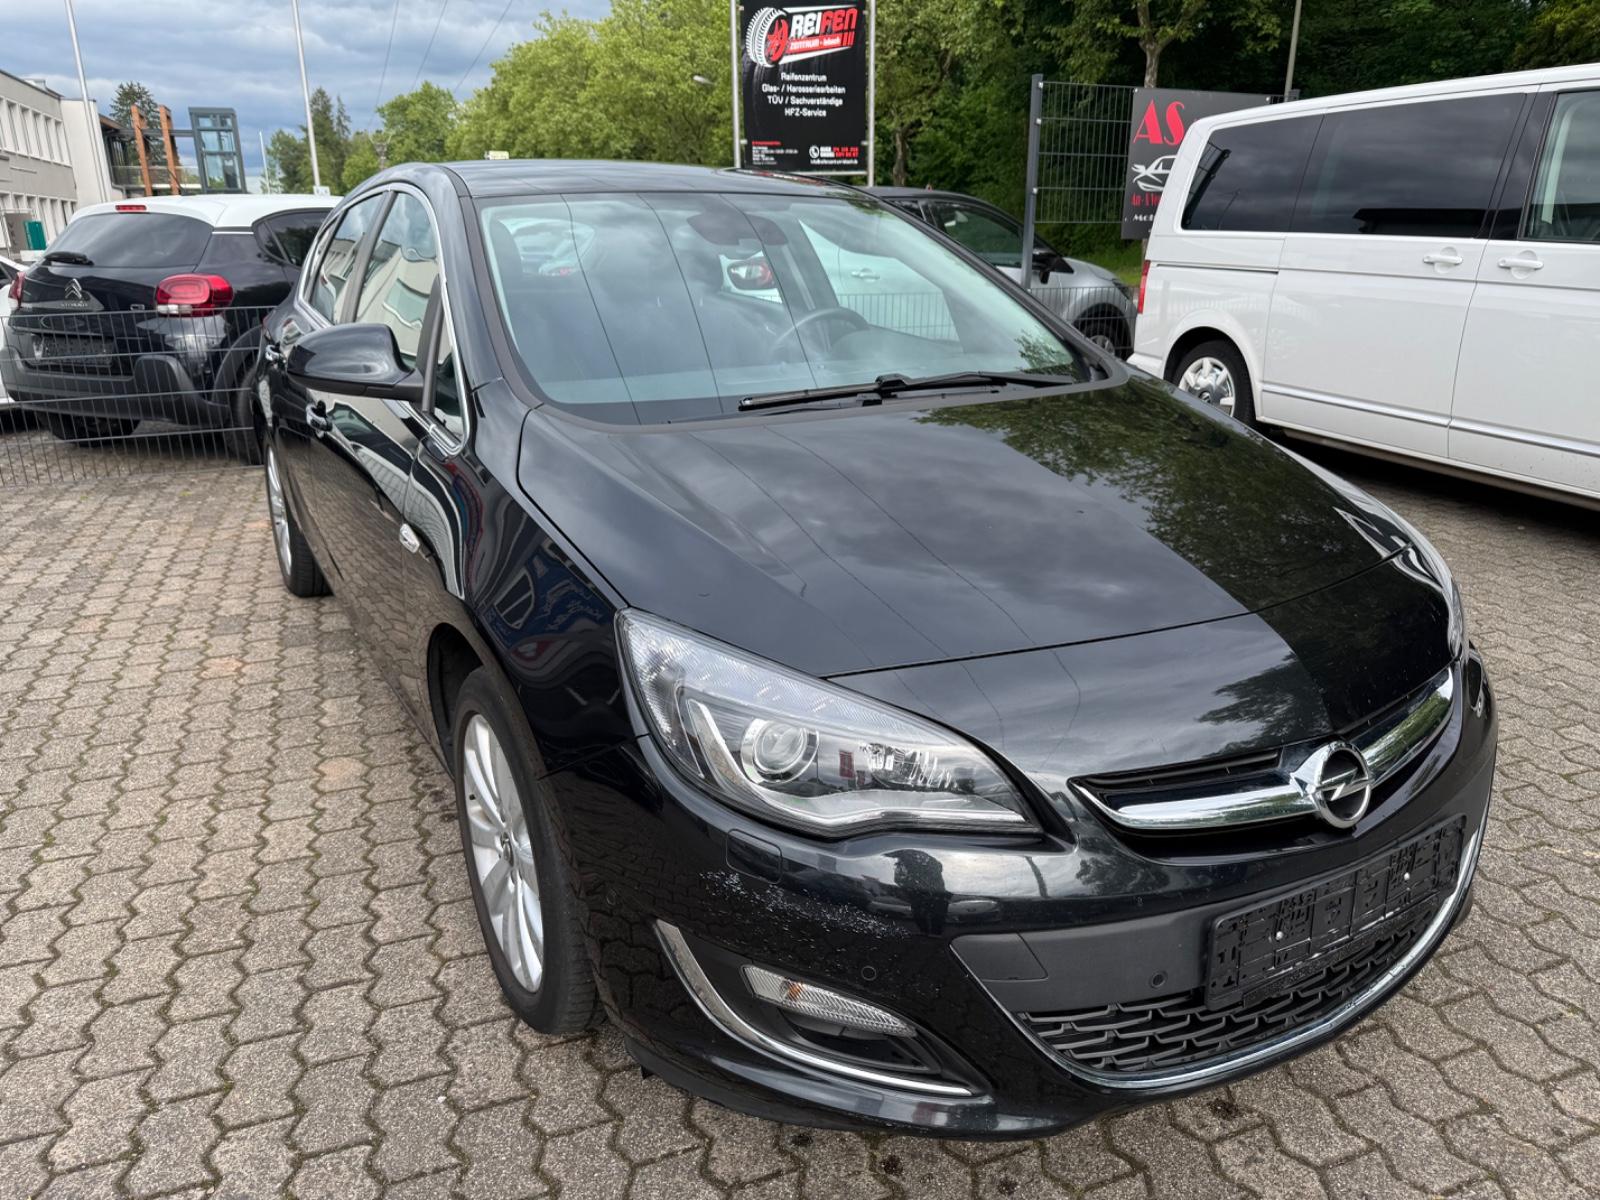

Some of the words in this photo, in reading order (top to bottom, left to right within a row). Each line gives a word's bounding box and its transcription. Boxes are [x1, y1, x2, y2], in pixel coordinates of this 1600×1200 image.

[790, 8, 858, 39] REIFEN
[780, 72, 827, 81] Reifenzentrum
[767, 95, 784, 104] TÜV
[790, 95, 843, 107] Sachverständige
[1133, 99, 1185, 146] AS
